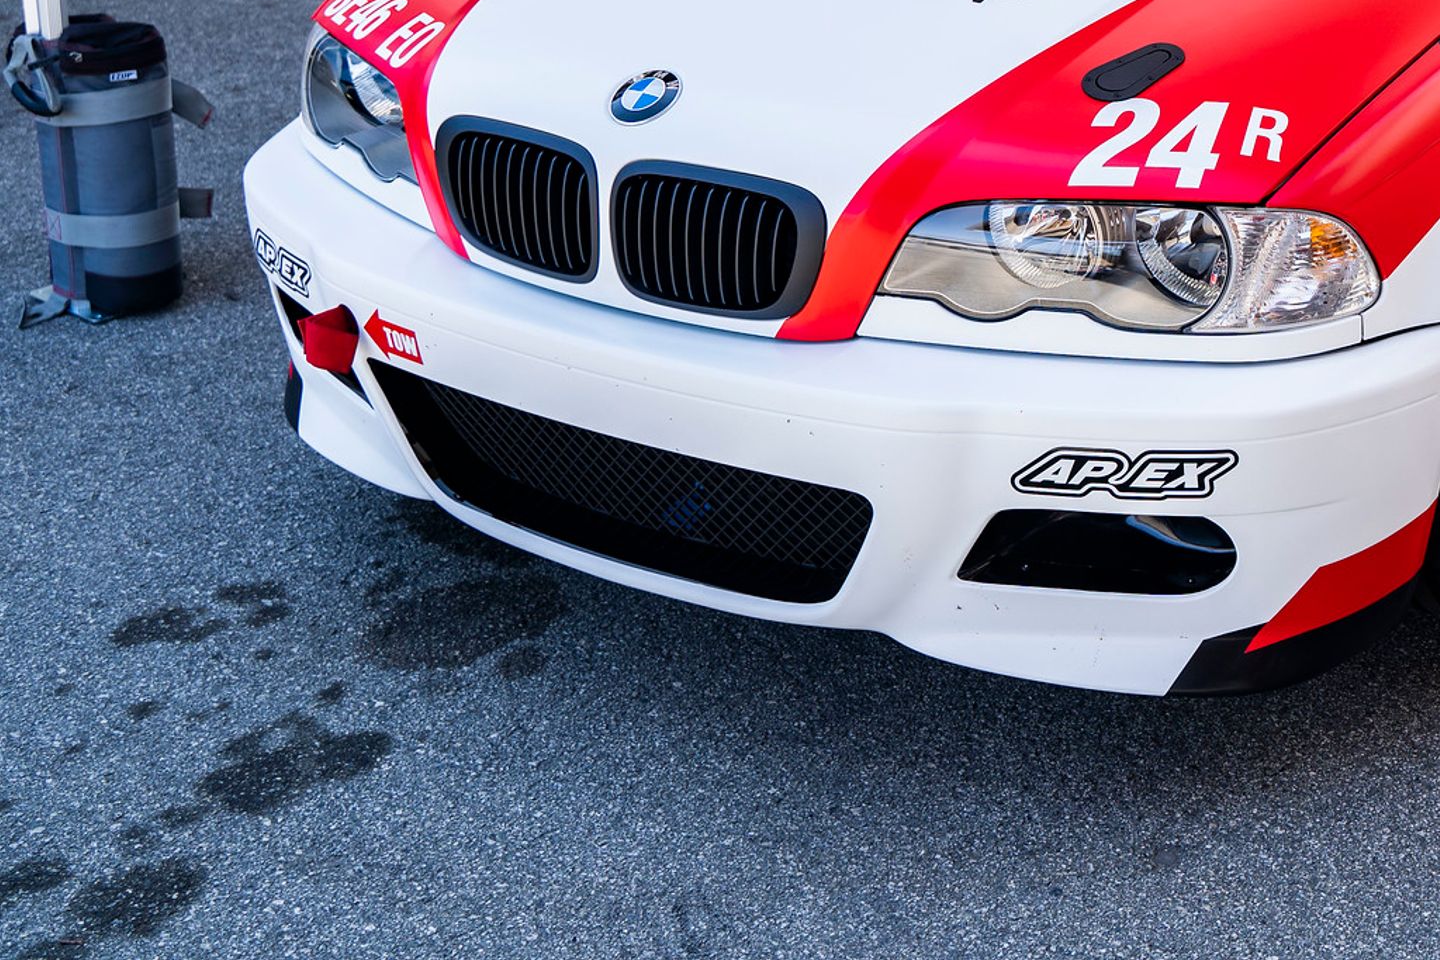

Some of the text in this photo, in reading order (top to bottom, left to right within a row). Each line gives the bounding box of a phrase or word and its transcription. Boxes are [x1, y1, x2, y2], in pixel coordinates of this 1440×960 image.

[1066, 97, 1290, 189] 24 R
[255, 236, 307, 287] APEX
[382, 325, 419, 358] TOW
[1026, 455, 1222, 492] APEX
